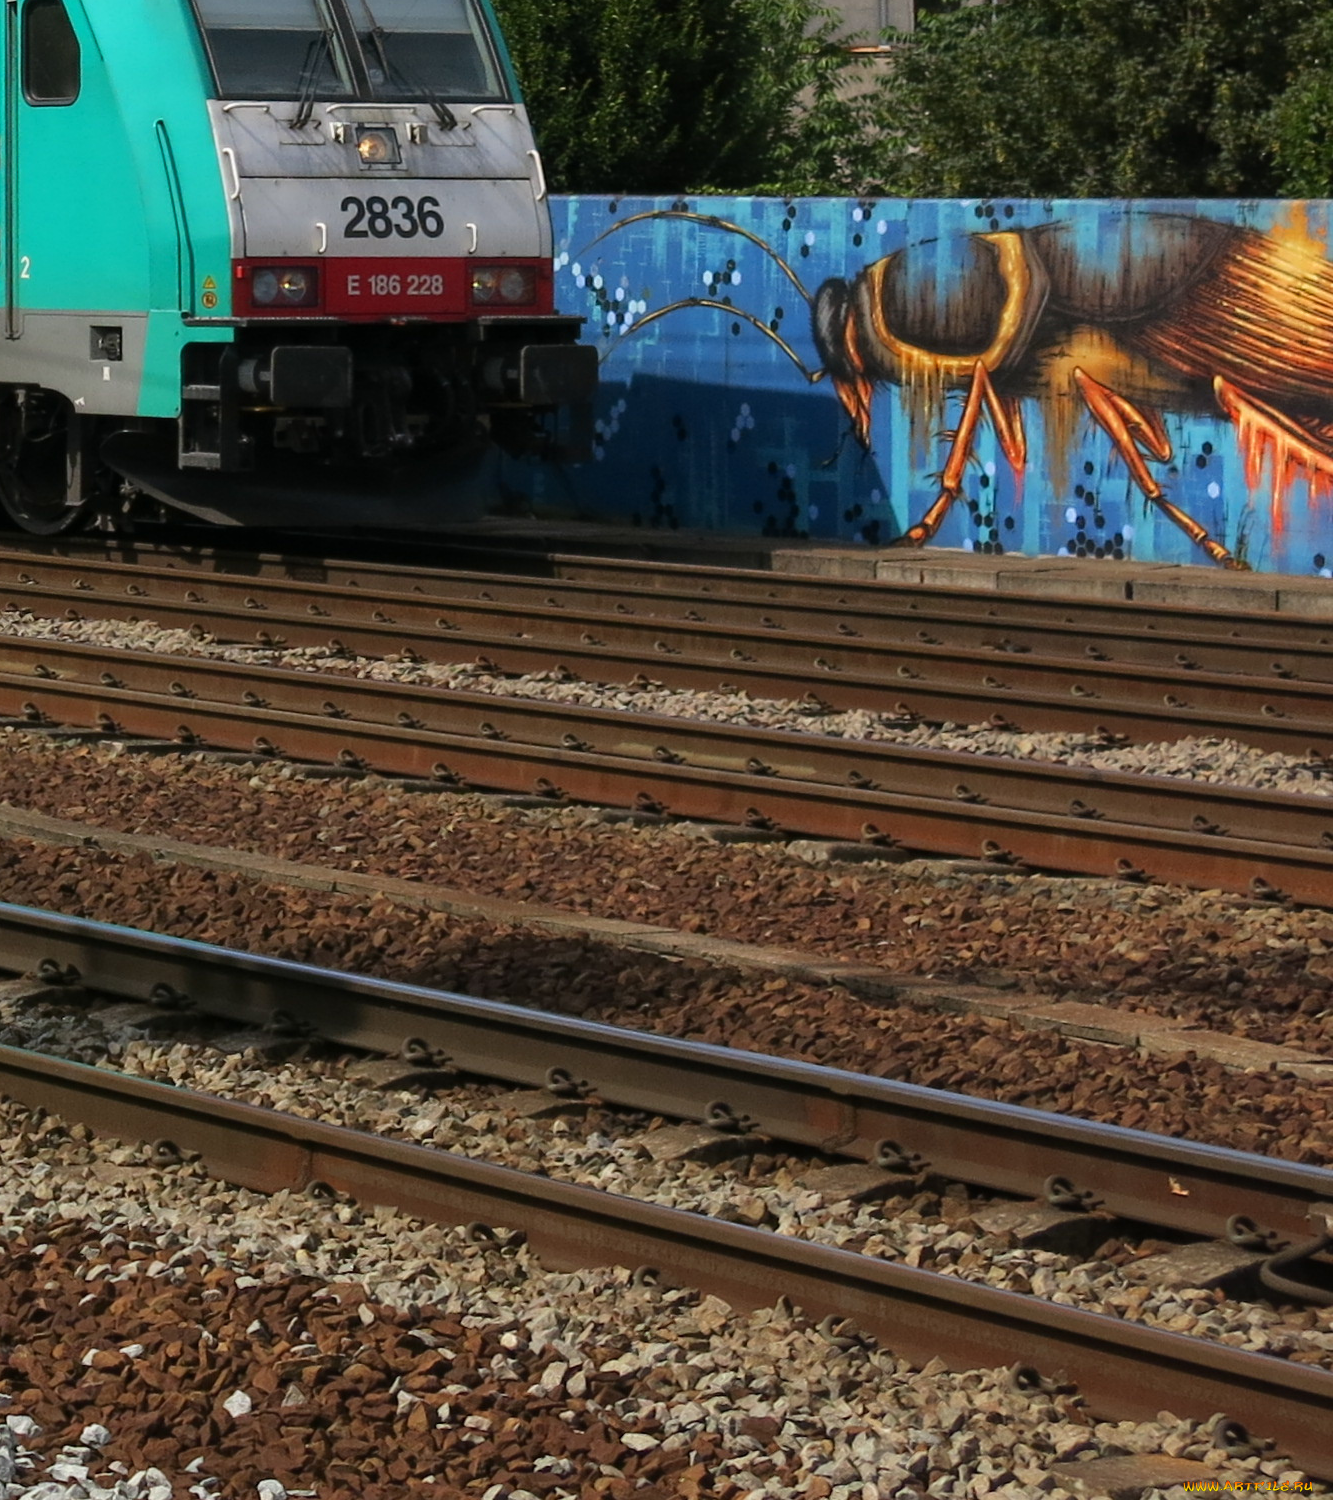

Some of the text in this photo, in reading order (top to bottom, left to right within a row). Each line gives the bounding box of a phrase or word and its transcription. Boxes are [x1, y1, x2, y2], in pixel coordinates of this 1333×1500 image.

[339, 195, 445, 239] 2836
[20, 256, 31, 279] 2
[347, 274, 444, 296] E 186 228
